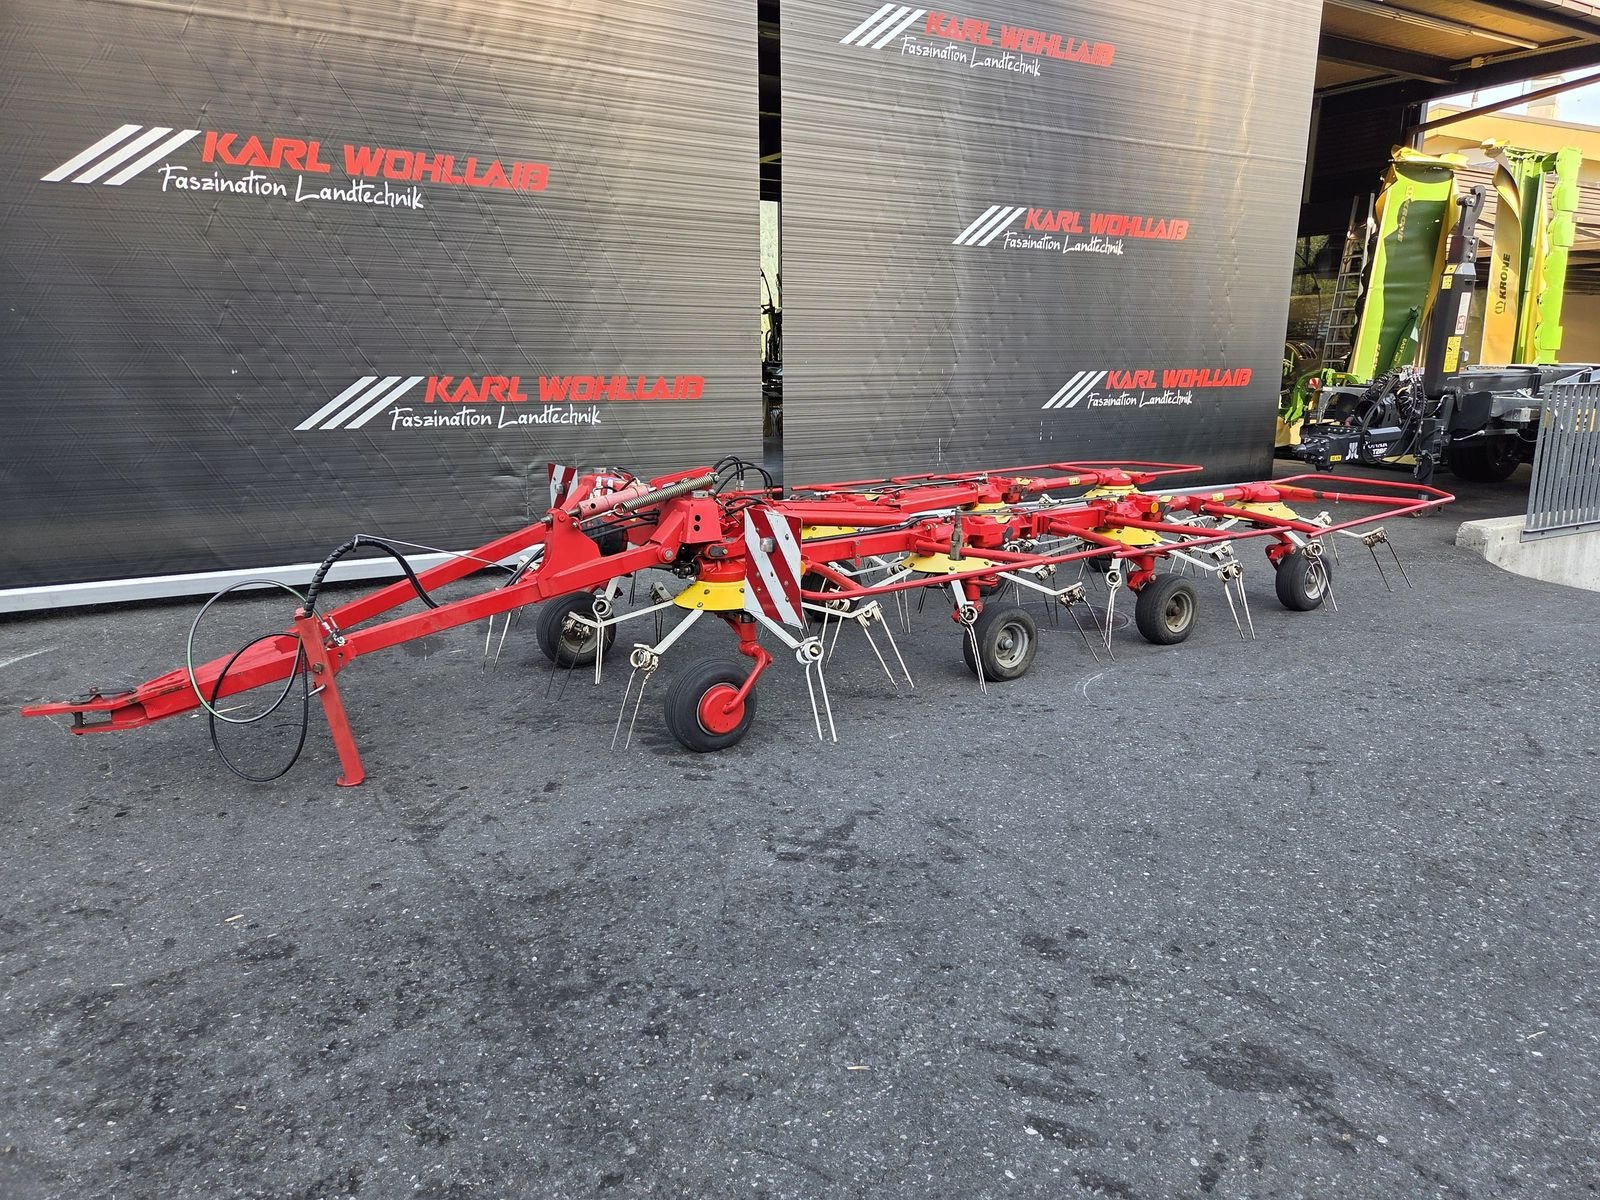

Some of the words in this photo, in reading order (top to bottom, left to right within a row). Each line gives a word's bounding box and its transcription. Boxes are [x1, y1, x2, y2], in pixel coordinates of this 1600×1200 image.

[924, 11, 993, 46] KARL
[900, 34, 967, 63] Faszination
[970, 47, 1041, 77] Landtechnik
[202, 131, 331, 173] KARL
[343, 144, 550, 192] WOHLLAIB
[157, 163, 288, 196] Faszination
[295, 175, 424, 209] Landtechnik
[1024, 208, 1084, 233] KARL
[1003, 230, 1061, 250] Faszination
[1063, 235, 1123, 255] Landtechnik
[1499, 253, 1511, 300] KRONE
[424, 375, 528, 403] KARL
[539, 375, 706, 401] WOHLLAIB
[1105, 370, 1157, 389] KARL
[1087, 391, 1137, 409] Faszination
[1139, 389, 1192, 408] Landtechnik
[388, 405, 491, 431] Faszination
[498, 404, 601, 429] Landtechnik
